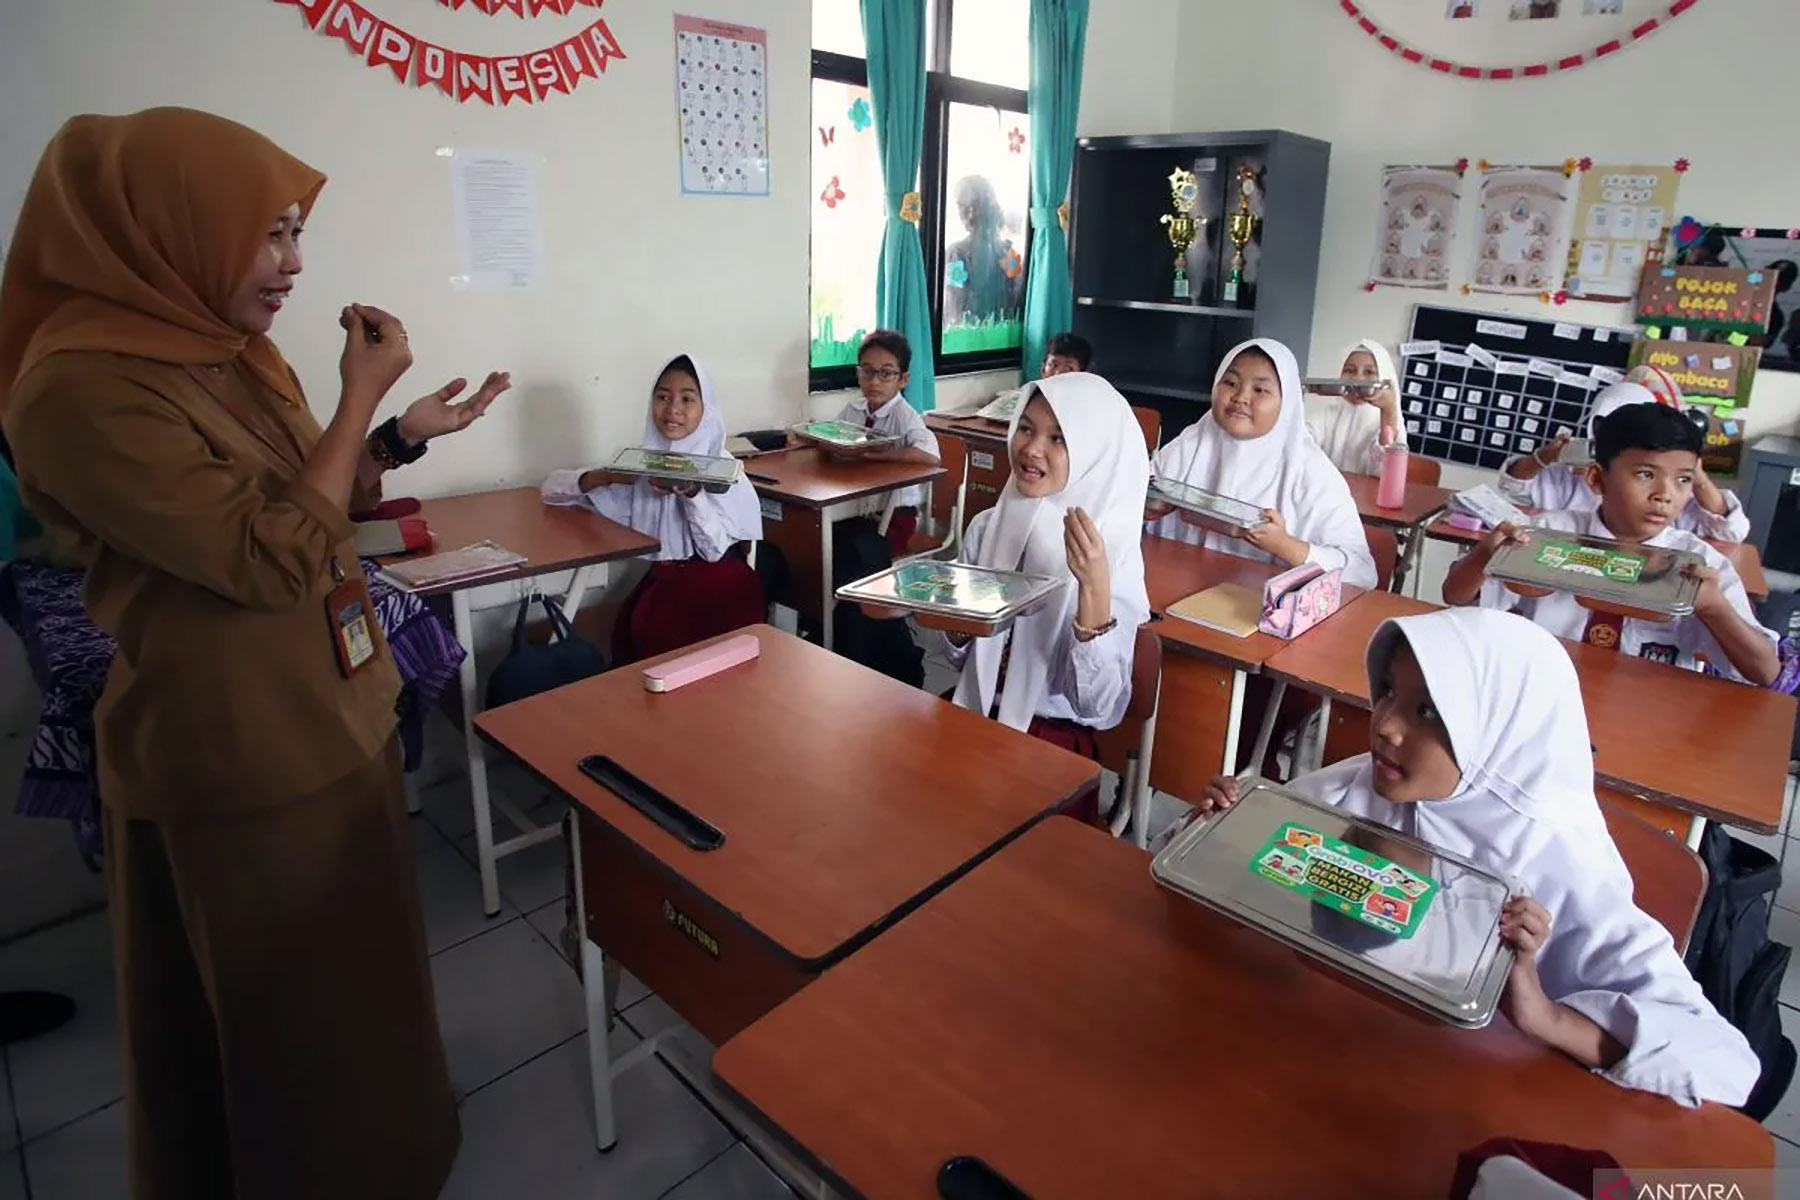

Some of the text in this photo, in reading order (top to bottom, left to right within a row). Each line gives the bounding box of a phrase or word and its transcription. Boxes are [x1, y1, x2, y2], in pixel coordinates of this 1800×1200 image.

[301, 0, 614, 91] NDONESIA
[1676, 277, 1738, 294] POJOK
[1678, 295, 1728, 311] BACA
[1310, 867, 1367, 894] BERGIZI
[1317, 861, 1370, 887] MAKAN
[1353, 864, 1393, 885] OVO
[1308, 875, 1360, 901] GRATIS
